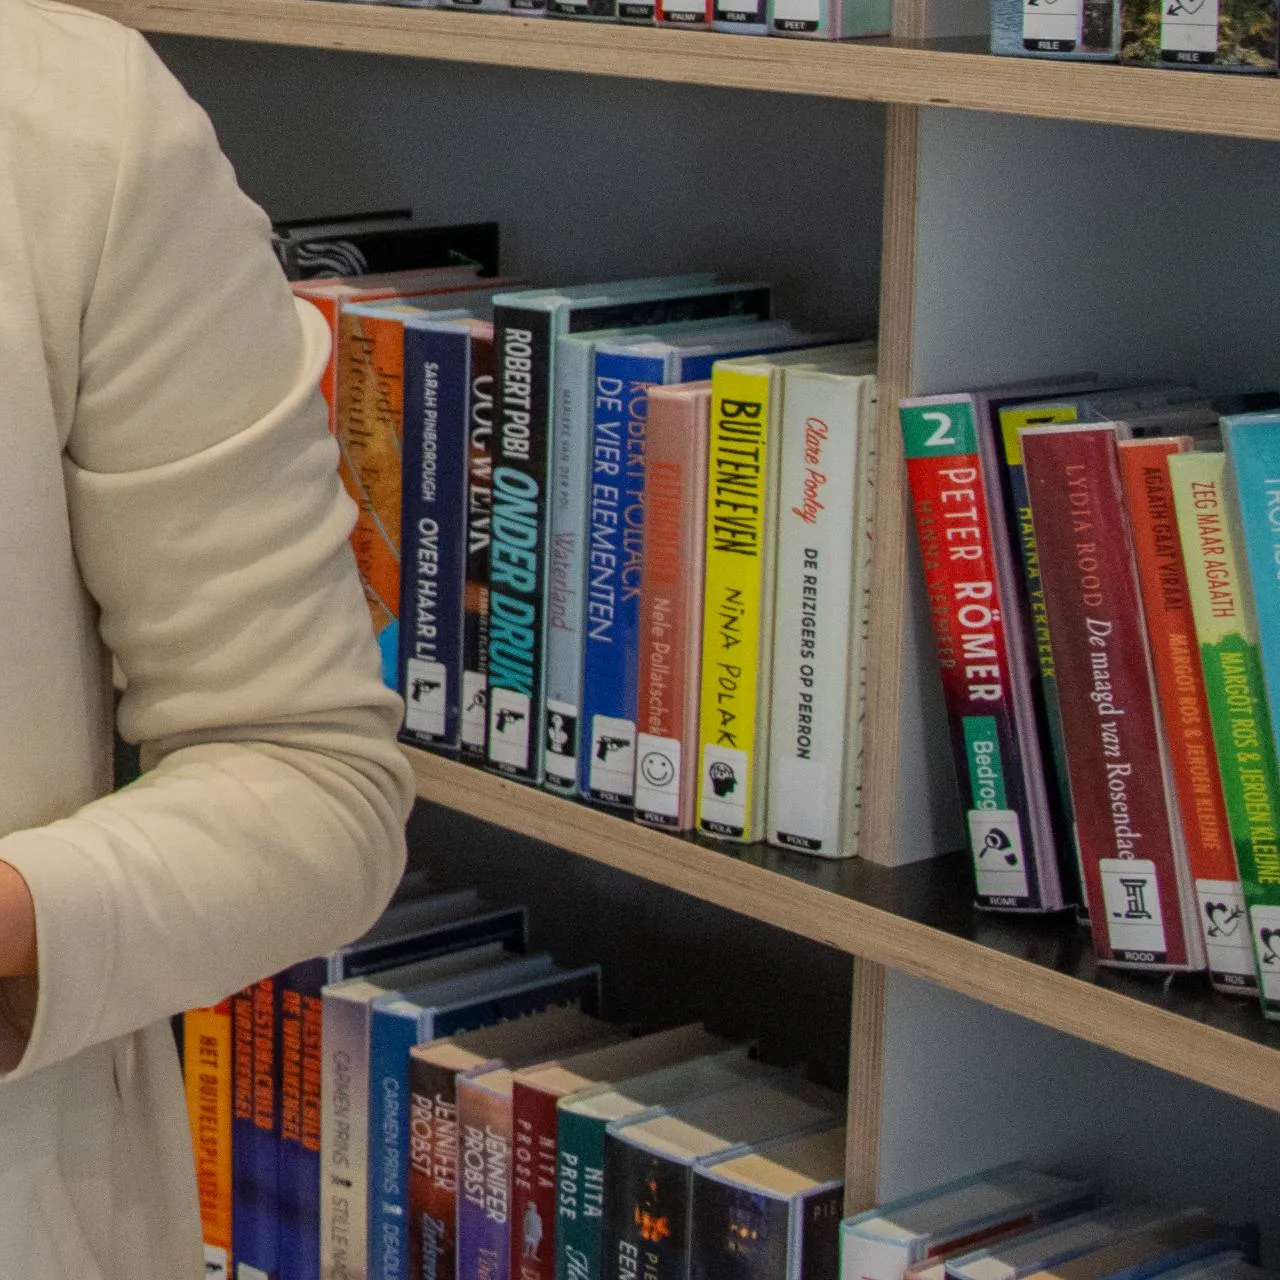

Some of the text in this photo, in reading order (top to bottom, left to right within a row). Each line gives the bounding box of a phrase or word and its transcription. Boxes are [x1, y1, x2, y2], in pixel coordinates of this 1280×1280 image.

[924, 412, 956, 448] 2
[491, 467, 542, 579] ONDER
[586, 376, 624, 644] DE VIER ELEMENTEN
[938, 465, 1003, 704] PETER RÖMER
[796, 548, 818, 761] DE REIZIGERS OP PERRON
[464, 1124, 485, 1208] PROBST
[484, 1124, 508, 1225] JENNIFER
